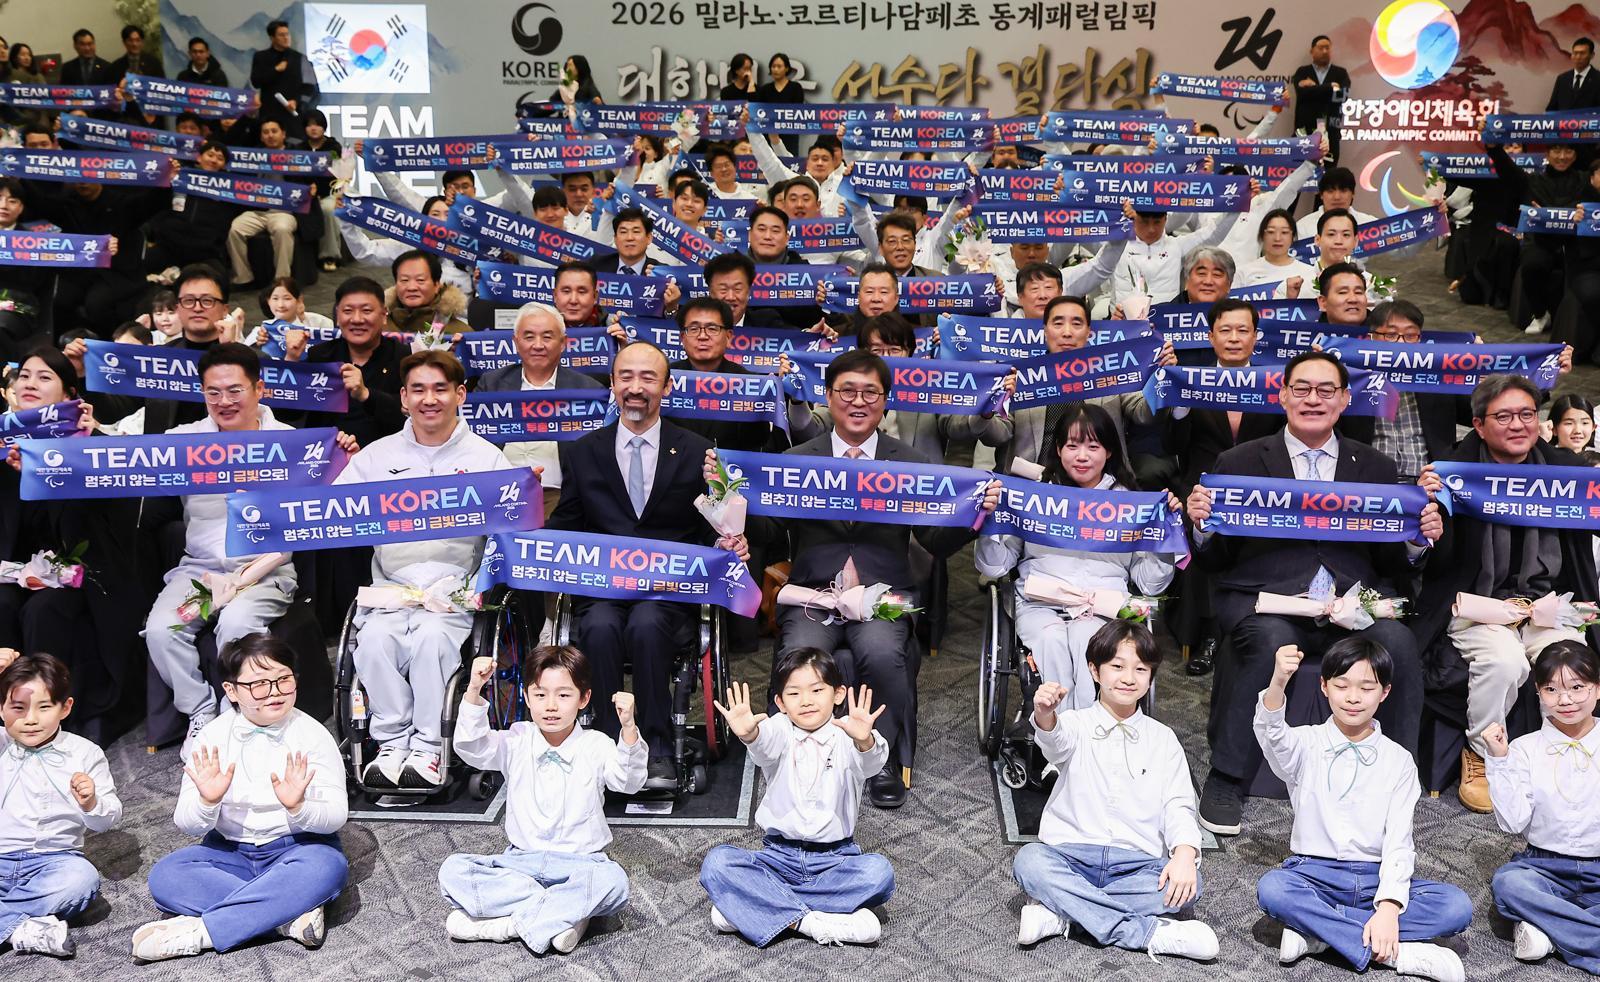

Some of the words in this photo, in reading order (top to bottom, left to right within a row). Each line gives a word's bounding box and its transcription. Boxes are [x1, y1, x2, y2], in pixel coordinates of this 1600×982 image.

[612, 2, 685, 25] 2026
[695, 1, 980, 30] 밀라노·코르티나담페초
[988, 1, 1157, 31] 동계패럴림픽
[502, 61, 560, 78] KORE
[12, 87, 48, 97] TEAM
[149, 81, 185, 95] TEAM
[188, 87, 231, 101] KOREA
[1178, 76, 1217, 88] TEAM
[1220, 80, 1266, 92] KOREA
[316, 105, 434, 138] TEAM
[598, 109, 636, 121] TEAM
[774, 109, 816, 120] TEAM
[820, 109, 867, 120] KOREA
[920, 109, 963, 120] KOREA
[86, 123, 127, 138] TEAM
[130, 130, 176, 146] KOREA
[527, 122, 561, 133] TEAM
[871, 126, 912, 138] TEAM
[917, 126, 965, 138] KOREA
[1073, 119, 1116, 130] TEAM
[1119, 121, 1168, 133] KOREA
[1512, 120, 1554, 130] TEAM
[1185, 135, 1231, 145] TEAM
[1357, 129, 1426, 141] PARALYMPIC
[1429, 129, 1482, 141] COMMITT
[231, 151, 267, 162] TEAM
[271, 153, 311, 165] KOREA
[393, 144, 440, 156] TEAM
[444, 142, 486, 155] KORE
[510, 147, 558, 160] TEAM
[562, 143, 616, 158] KOREA
[26, 155, 76, 167] TEAM
[80, 156, 137, 170] KOREA
[855, 161, 903, 177] TEAM
[908, 165, 966, 180] KOREA
[1073, 162, 1118, 173] TEAM
[1123, 162, 1176, 174] KOREA
[1447, 156, 1485, 166] TEAM
[188, 173, 231, 189] TEAM
[234, 181, 282, 197] KOREA
[1096, 179, 1148, 194] TEAM
[1153, 179, 1214, 195] KOREA
[982, 211, 1038, 225] TEAM
[1044, 209, 1109, 224] KOREA
[372, 203, 422, 231] TEAM
[424, 222, 479, 251] KOREA
[485, 211, 536, 240] TEAM
[538, 230, 594, 257] KOREA
[801, 222, 856, 237] KOREA
[1358, 219, 1414, 242] KOREA
[11, 236, 74, 250] KOREA
[513, 272, 555, 288] TEA
[752, 271, 814, 287] KOREA
[908, 280, 973, 295] KOREA
[1163, 312, 1209, 329] TEA
[980, 326, 1045, 345] TEAM
[465, 340, 517, 356] TEA
[1055, 350, 1139, 381] KOREA
[1358, 349, 1434, 370] TEAM
[1442, 352, 1529, 371] KOREA
[135, 377, 168, 390] 멈추지
[169, 380, 191, 393] 않는
[695, 375, 777, 396] KOREA
[894, 367, 977, 391] KOREA
[1181, 367, 1257, 389] TEAM
[1180, 389, 1214, 403] 멈추지
[1216, 391, 1238, 404] 않는
[1239, 392, 1265, 406] 도전,
[458, 402, 513, 419] EAM
[522, 399, 605, 418] KOREA
[83, 447, 176, 468] TEAM
[187, 442, 287, 466] KOREA
[85, 474, 126, 488] 멈추지
[129, 473, 156, 486] 않는
[159, 472, 189, 487] 도전,
[191, 470, 230, 484] 투혼의
[234, 468, 289, 483] 금빛으로!
[761, 466, 847, 491] TEAM
[857, 471, 958, 497] KOREA
[1485, 476, 1577, 499] TEAM
[280, 495, 370, 523] TEAM
[380, 485, 482, 515] KOREA
[760, 493, 798, 507] 멈추지
[801, 495, 826, 509] 않는
[829, 497, 858, 511] 도전,
[860, 498, 899, 513] 투혼의
[901, 500, 956, 515] 금빛으로!
[997, 487, 1068, 518] TEAM
[1077, 500, 1165, 524] KOREA
[1206, 487, 1292, 509] TEAM
[1301, 492, 1404, 515] KOREA
[1482, 501, 1522, 516] 멈추지
[1525, 503, 1552, 518] 않는
[1555, 505, 1586, 520] 도전,
[283, 528, 324, 541] 멈추지
[326, 526, 353, 538] 않는
[355, 523, 385, 537] 도전,
[387, 518, 426, 532] 투혼의
[429, 512, 486, 529] 금빛으로!
[994, 510, 1020, 527] 멈추지
[1022, 518, 1047, 534] 않는
[1049, 523, 1077, 539] 도전,
[1079, 529, 1117, 542] 투혼의
[1120, 528, 1165, 542] 금빛으로!
[1243, 513, 1269, 526] 않는
[1271, 515, 1301, 529] 도전,
[1303, 517, 1343, 530] 투혼의
[1345, 518, 1404, 533] 금빛으로!
[514, 538, 600, 567] TEAM
[609, 547, 709, 577] KOREA
[511, 565, 550, 581] 멈추지
[553, 570, 578, 584] 않는
[580, 573, 609, 588] 도전,
[612, 575, 650, 592] 투혼의
[653, 580, 709, 595] 금빛으로!
